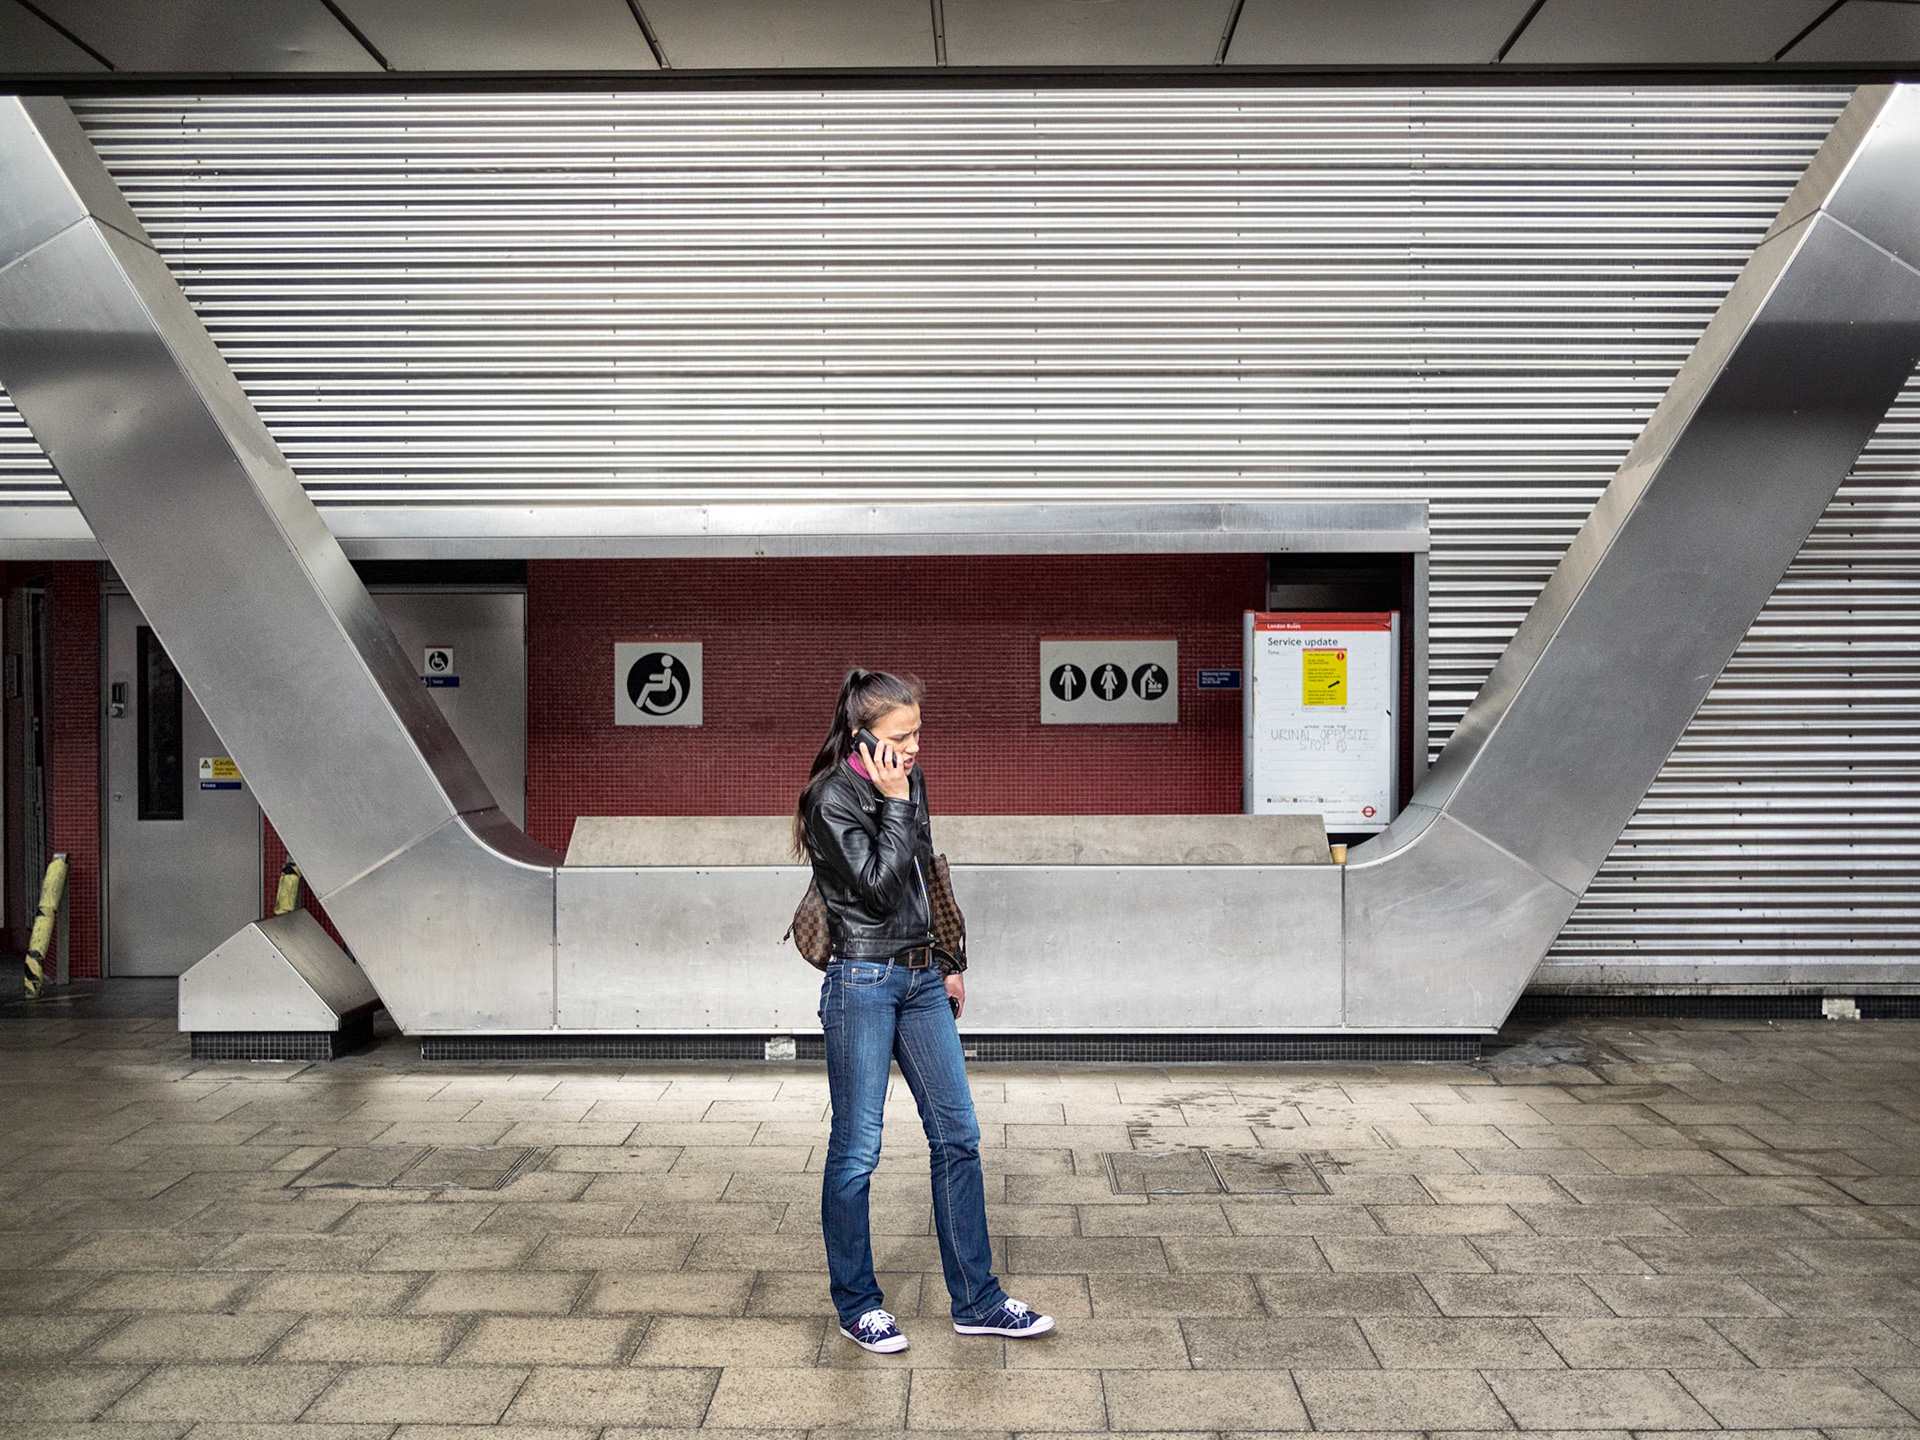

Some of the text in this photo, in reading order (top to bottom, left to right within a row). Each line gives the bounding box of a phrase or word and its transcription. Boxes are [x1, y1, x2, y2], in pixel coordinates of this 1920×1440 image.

[1267, 637, 1338, 647] Service update
[1270, 729, 1370, 741] URINAL OPPOSITE
